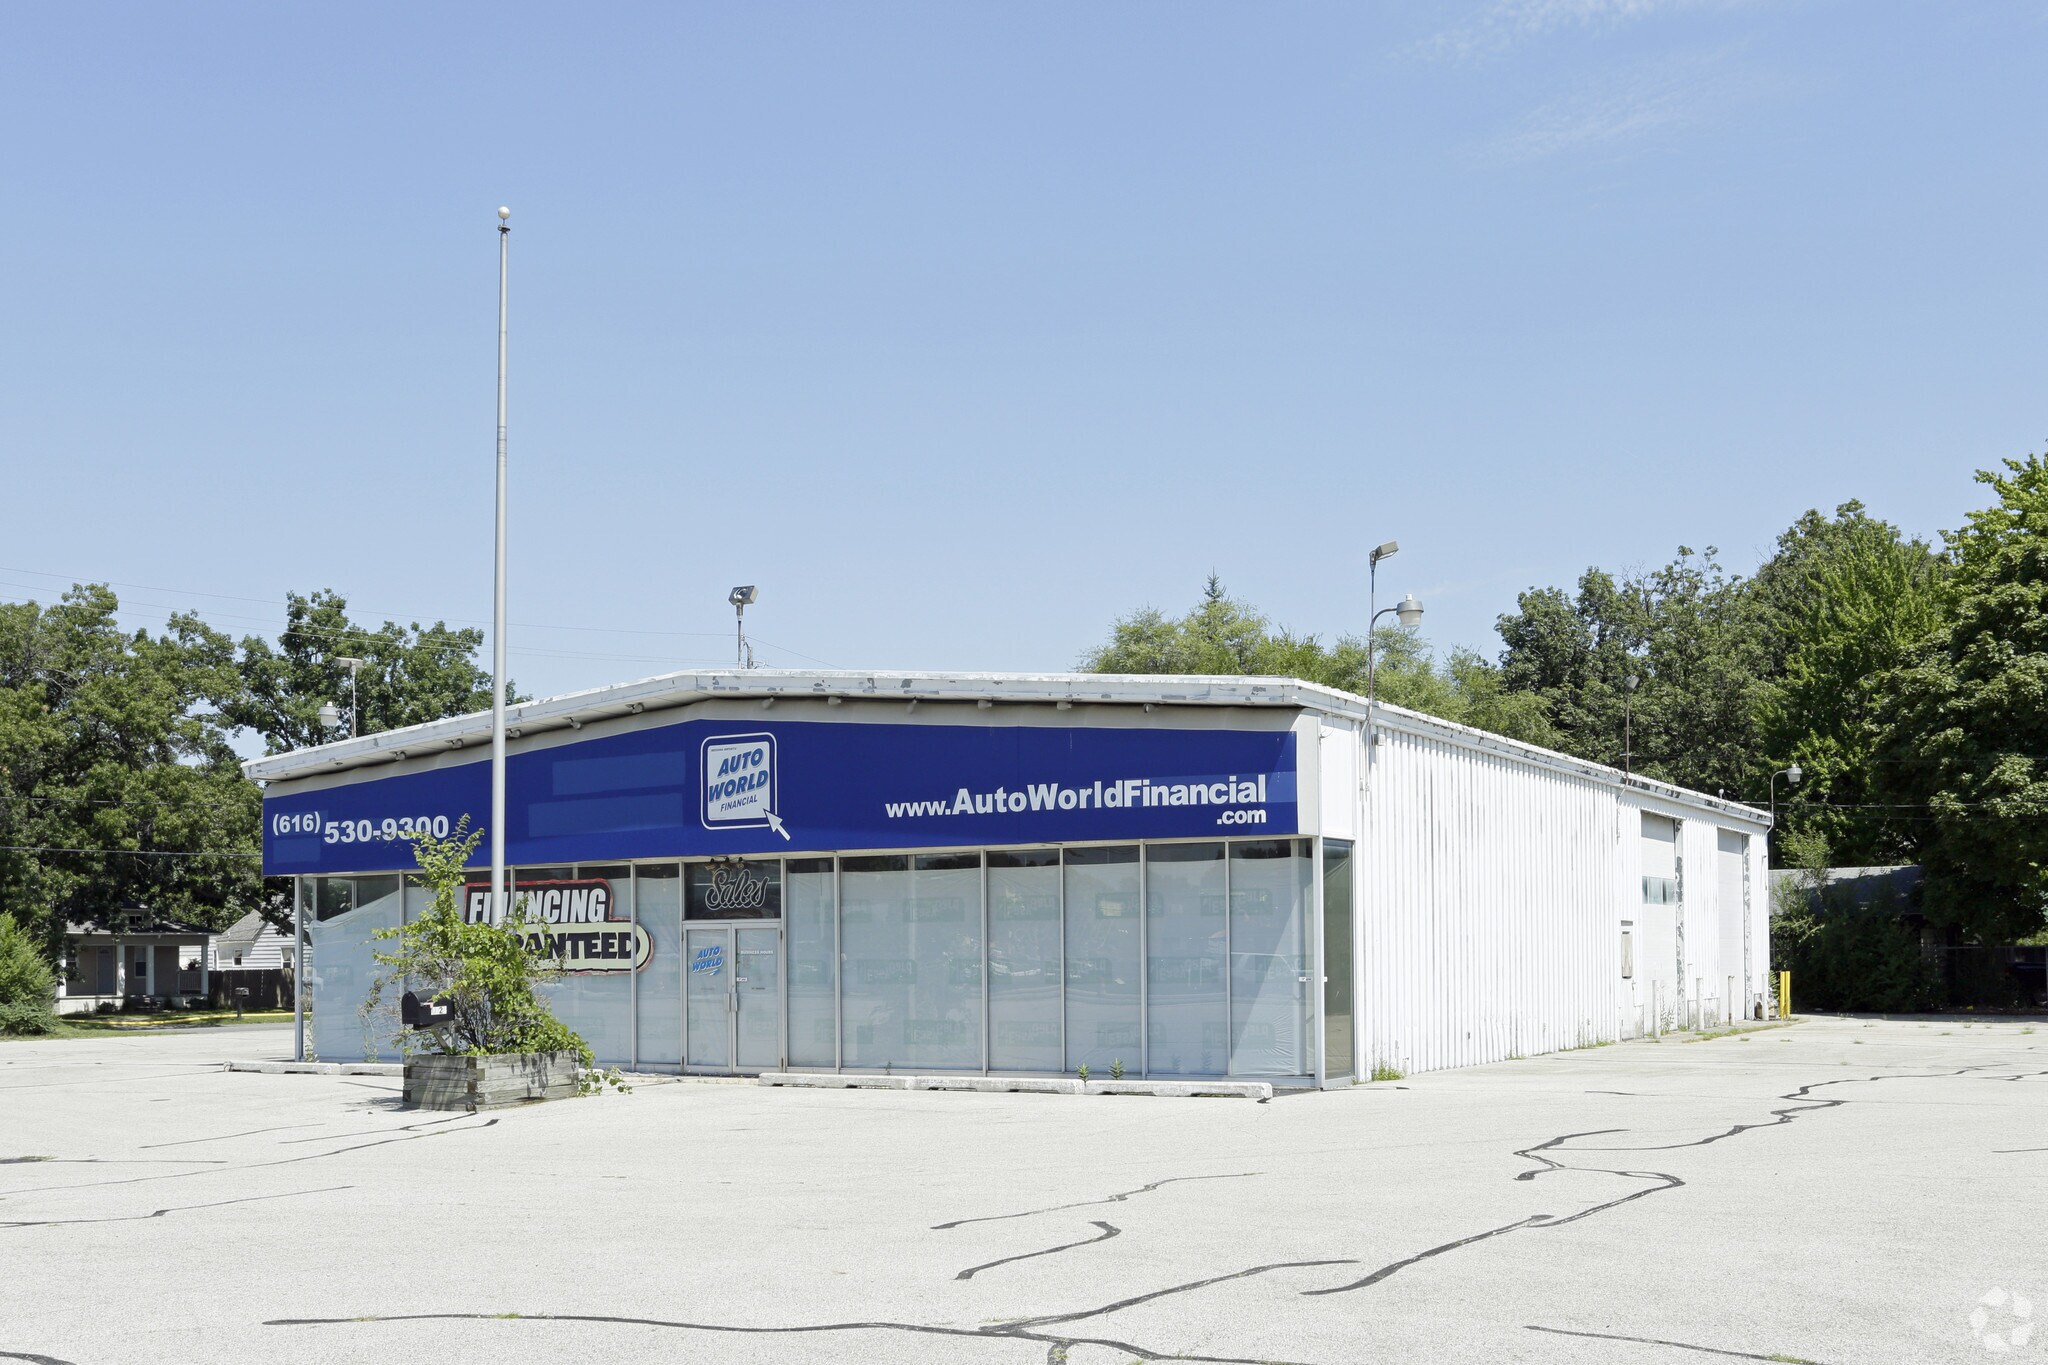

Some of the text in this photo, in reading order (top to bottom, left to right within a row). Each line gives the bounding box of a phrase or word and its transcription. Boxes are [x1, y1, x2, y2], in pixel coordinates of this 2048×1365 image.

[717, 748, 764, 778] AUTO
[708, 770, 769, 803] WORLD
[885, 774, 1267, 818] www.AutoWorldFinancial
[720, 794, 758, 812] FINANCIAL
[1216, 807, 1267, 825] .com
[272, 811, 449, 844] (616) 530-9300
[705, 868, 769, 911] Sales
[691, 957, 724, 973] WORLD
[697, 946, 721, 960] AUTO
